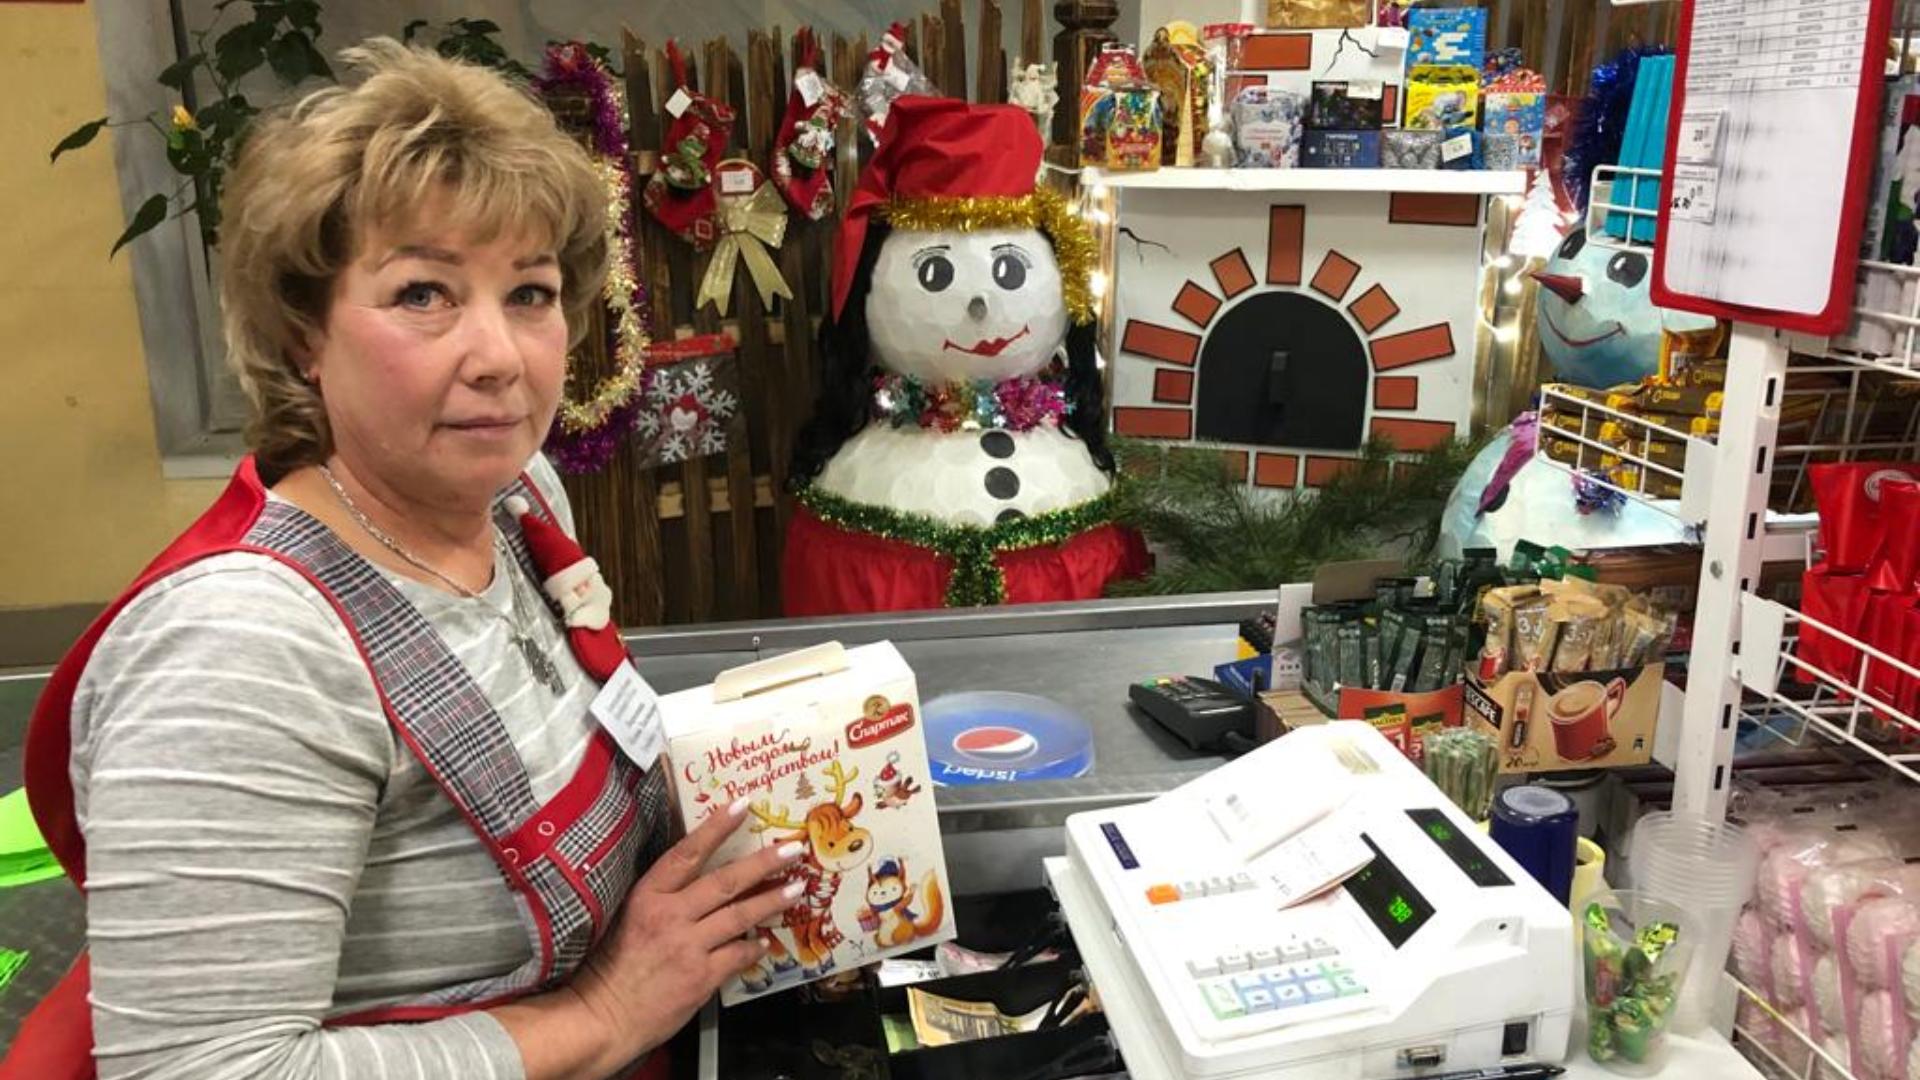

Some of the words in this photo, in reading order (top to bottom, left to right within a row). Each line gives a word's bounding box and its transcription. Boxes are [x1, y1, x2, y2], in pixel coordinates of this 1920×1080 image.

[849, 711, 909, 742] Спартак
[705, 728, 790, 774] Новым
[718, 740, 840, 800] Рождеством!
[737, 737, 811, 771] годом
